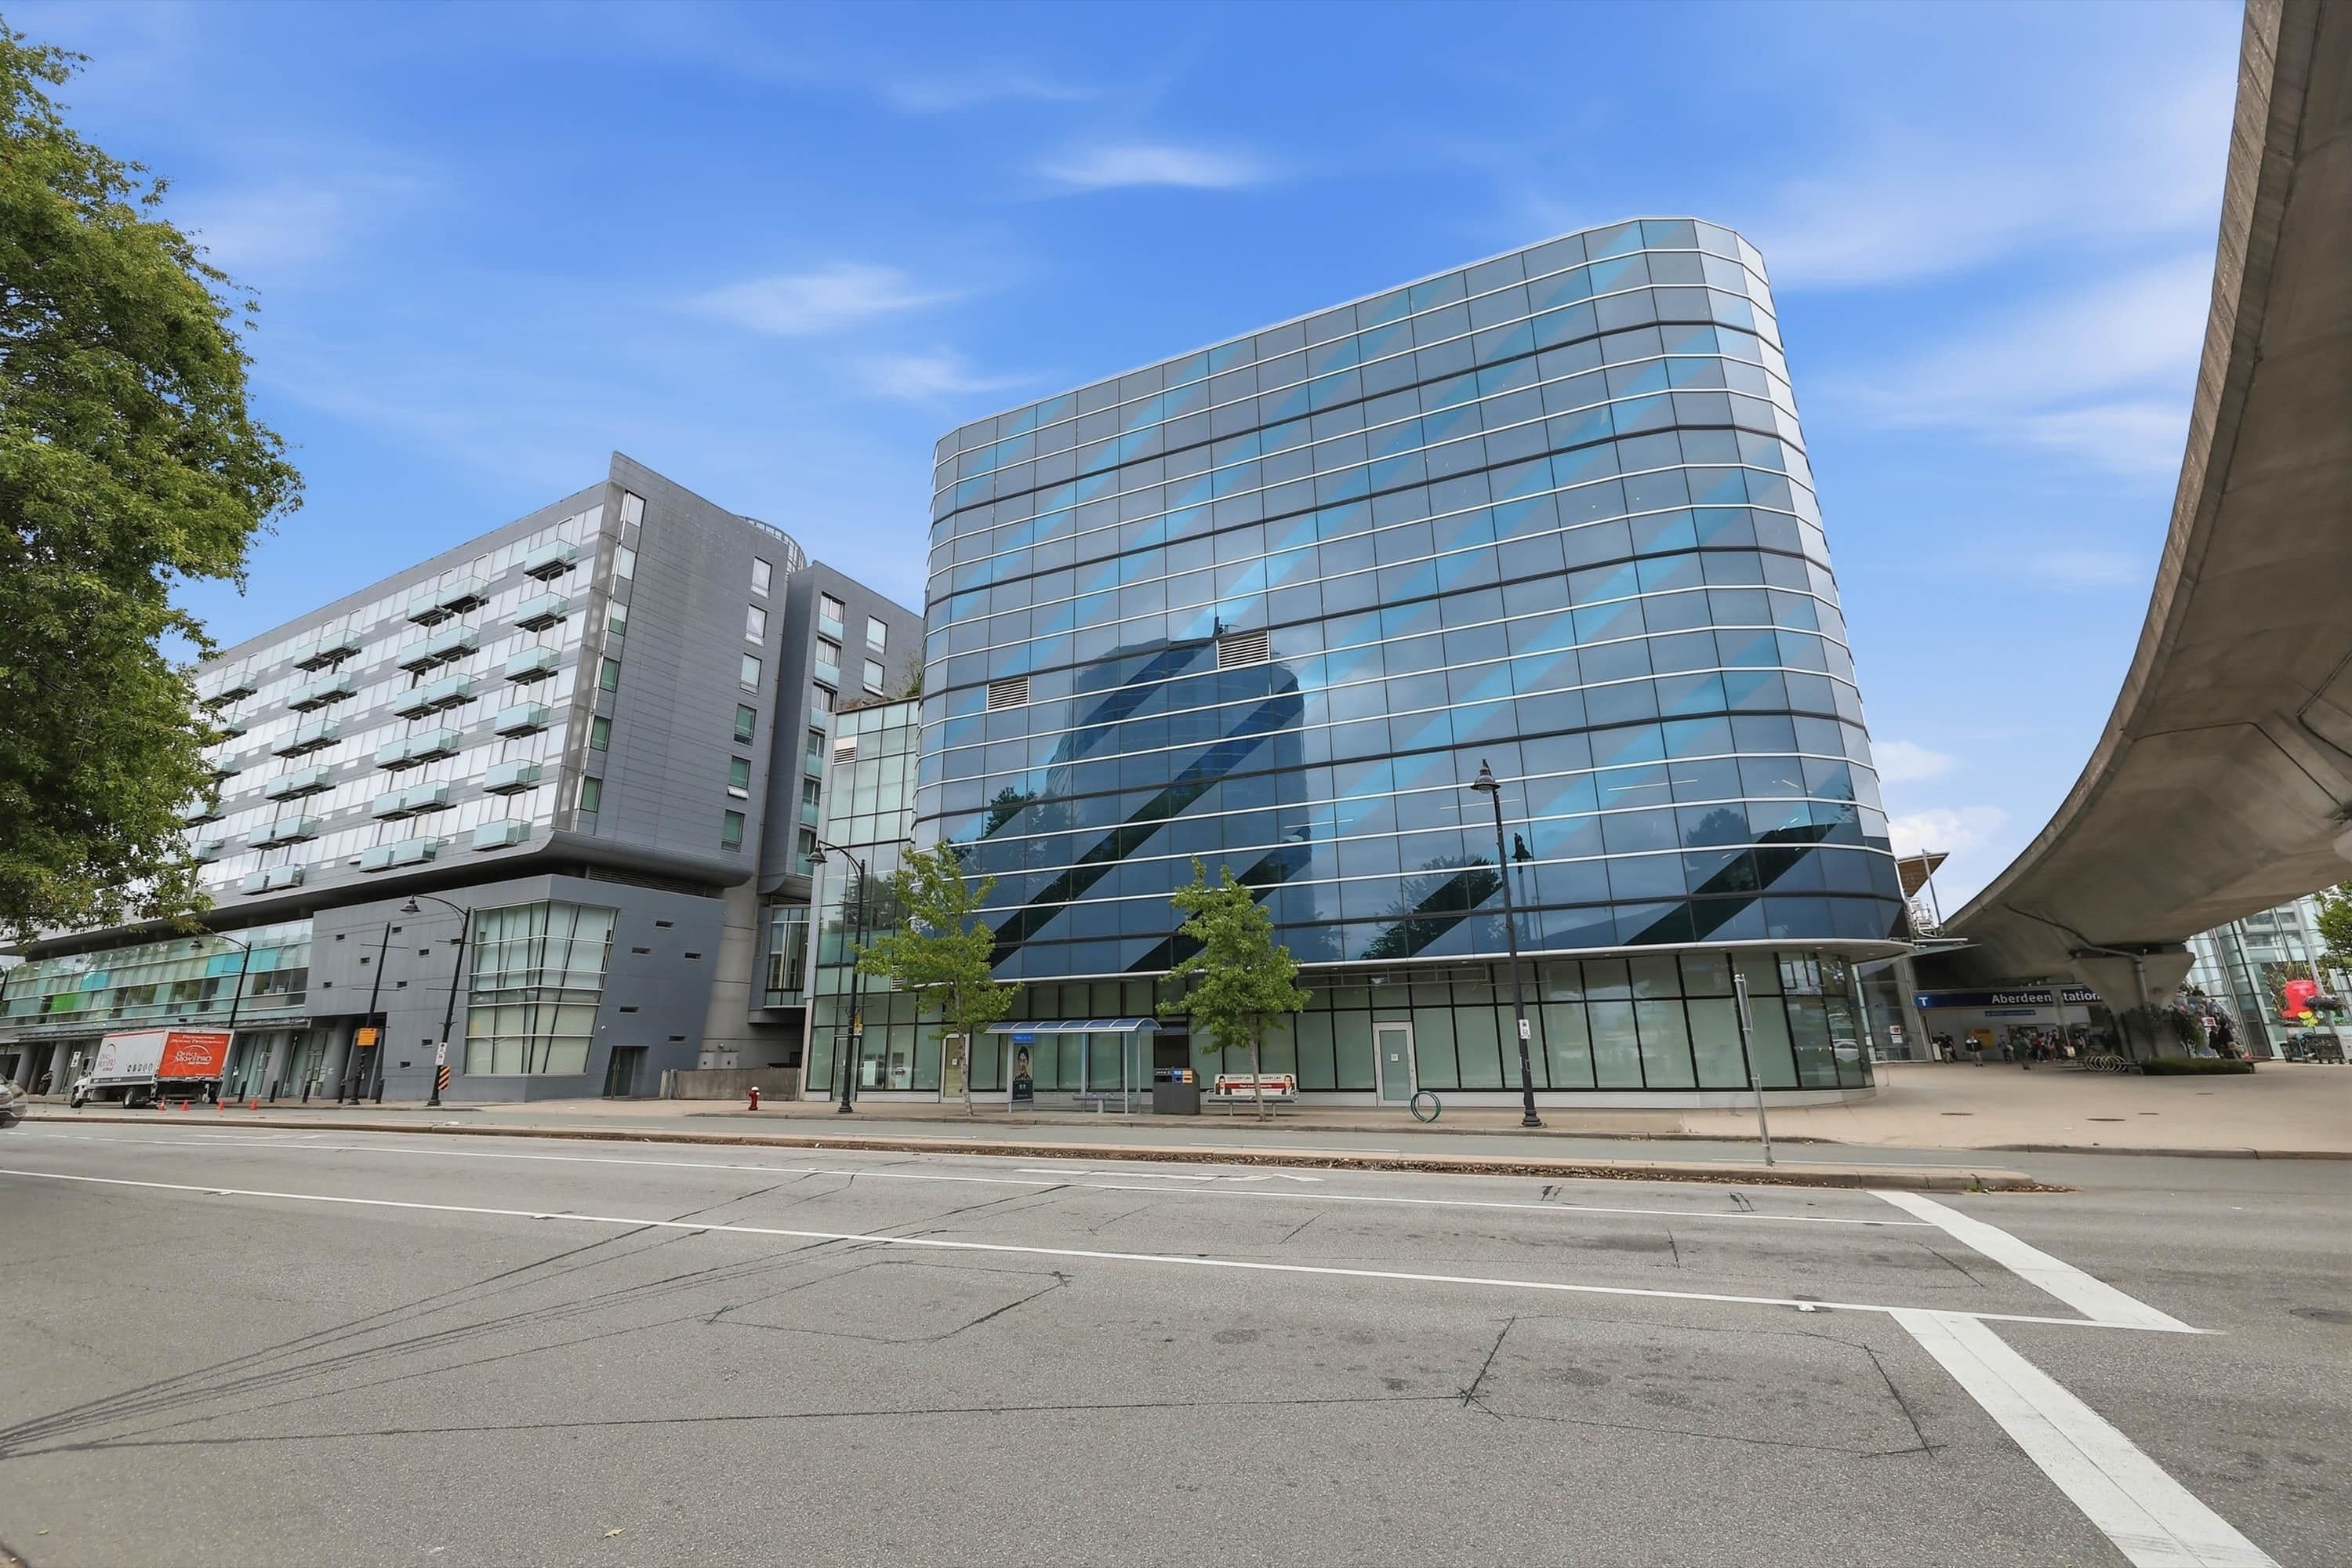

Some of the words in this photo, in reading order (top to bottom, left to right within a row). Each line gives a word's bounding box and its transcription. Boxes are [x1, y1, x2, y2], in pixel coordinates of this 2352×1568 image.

[1918, 997, 1928, 1007] T
[1991, 992, 2052, 1004] Aberdeen
[2063, 989, 2100, 1002] tation
